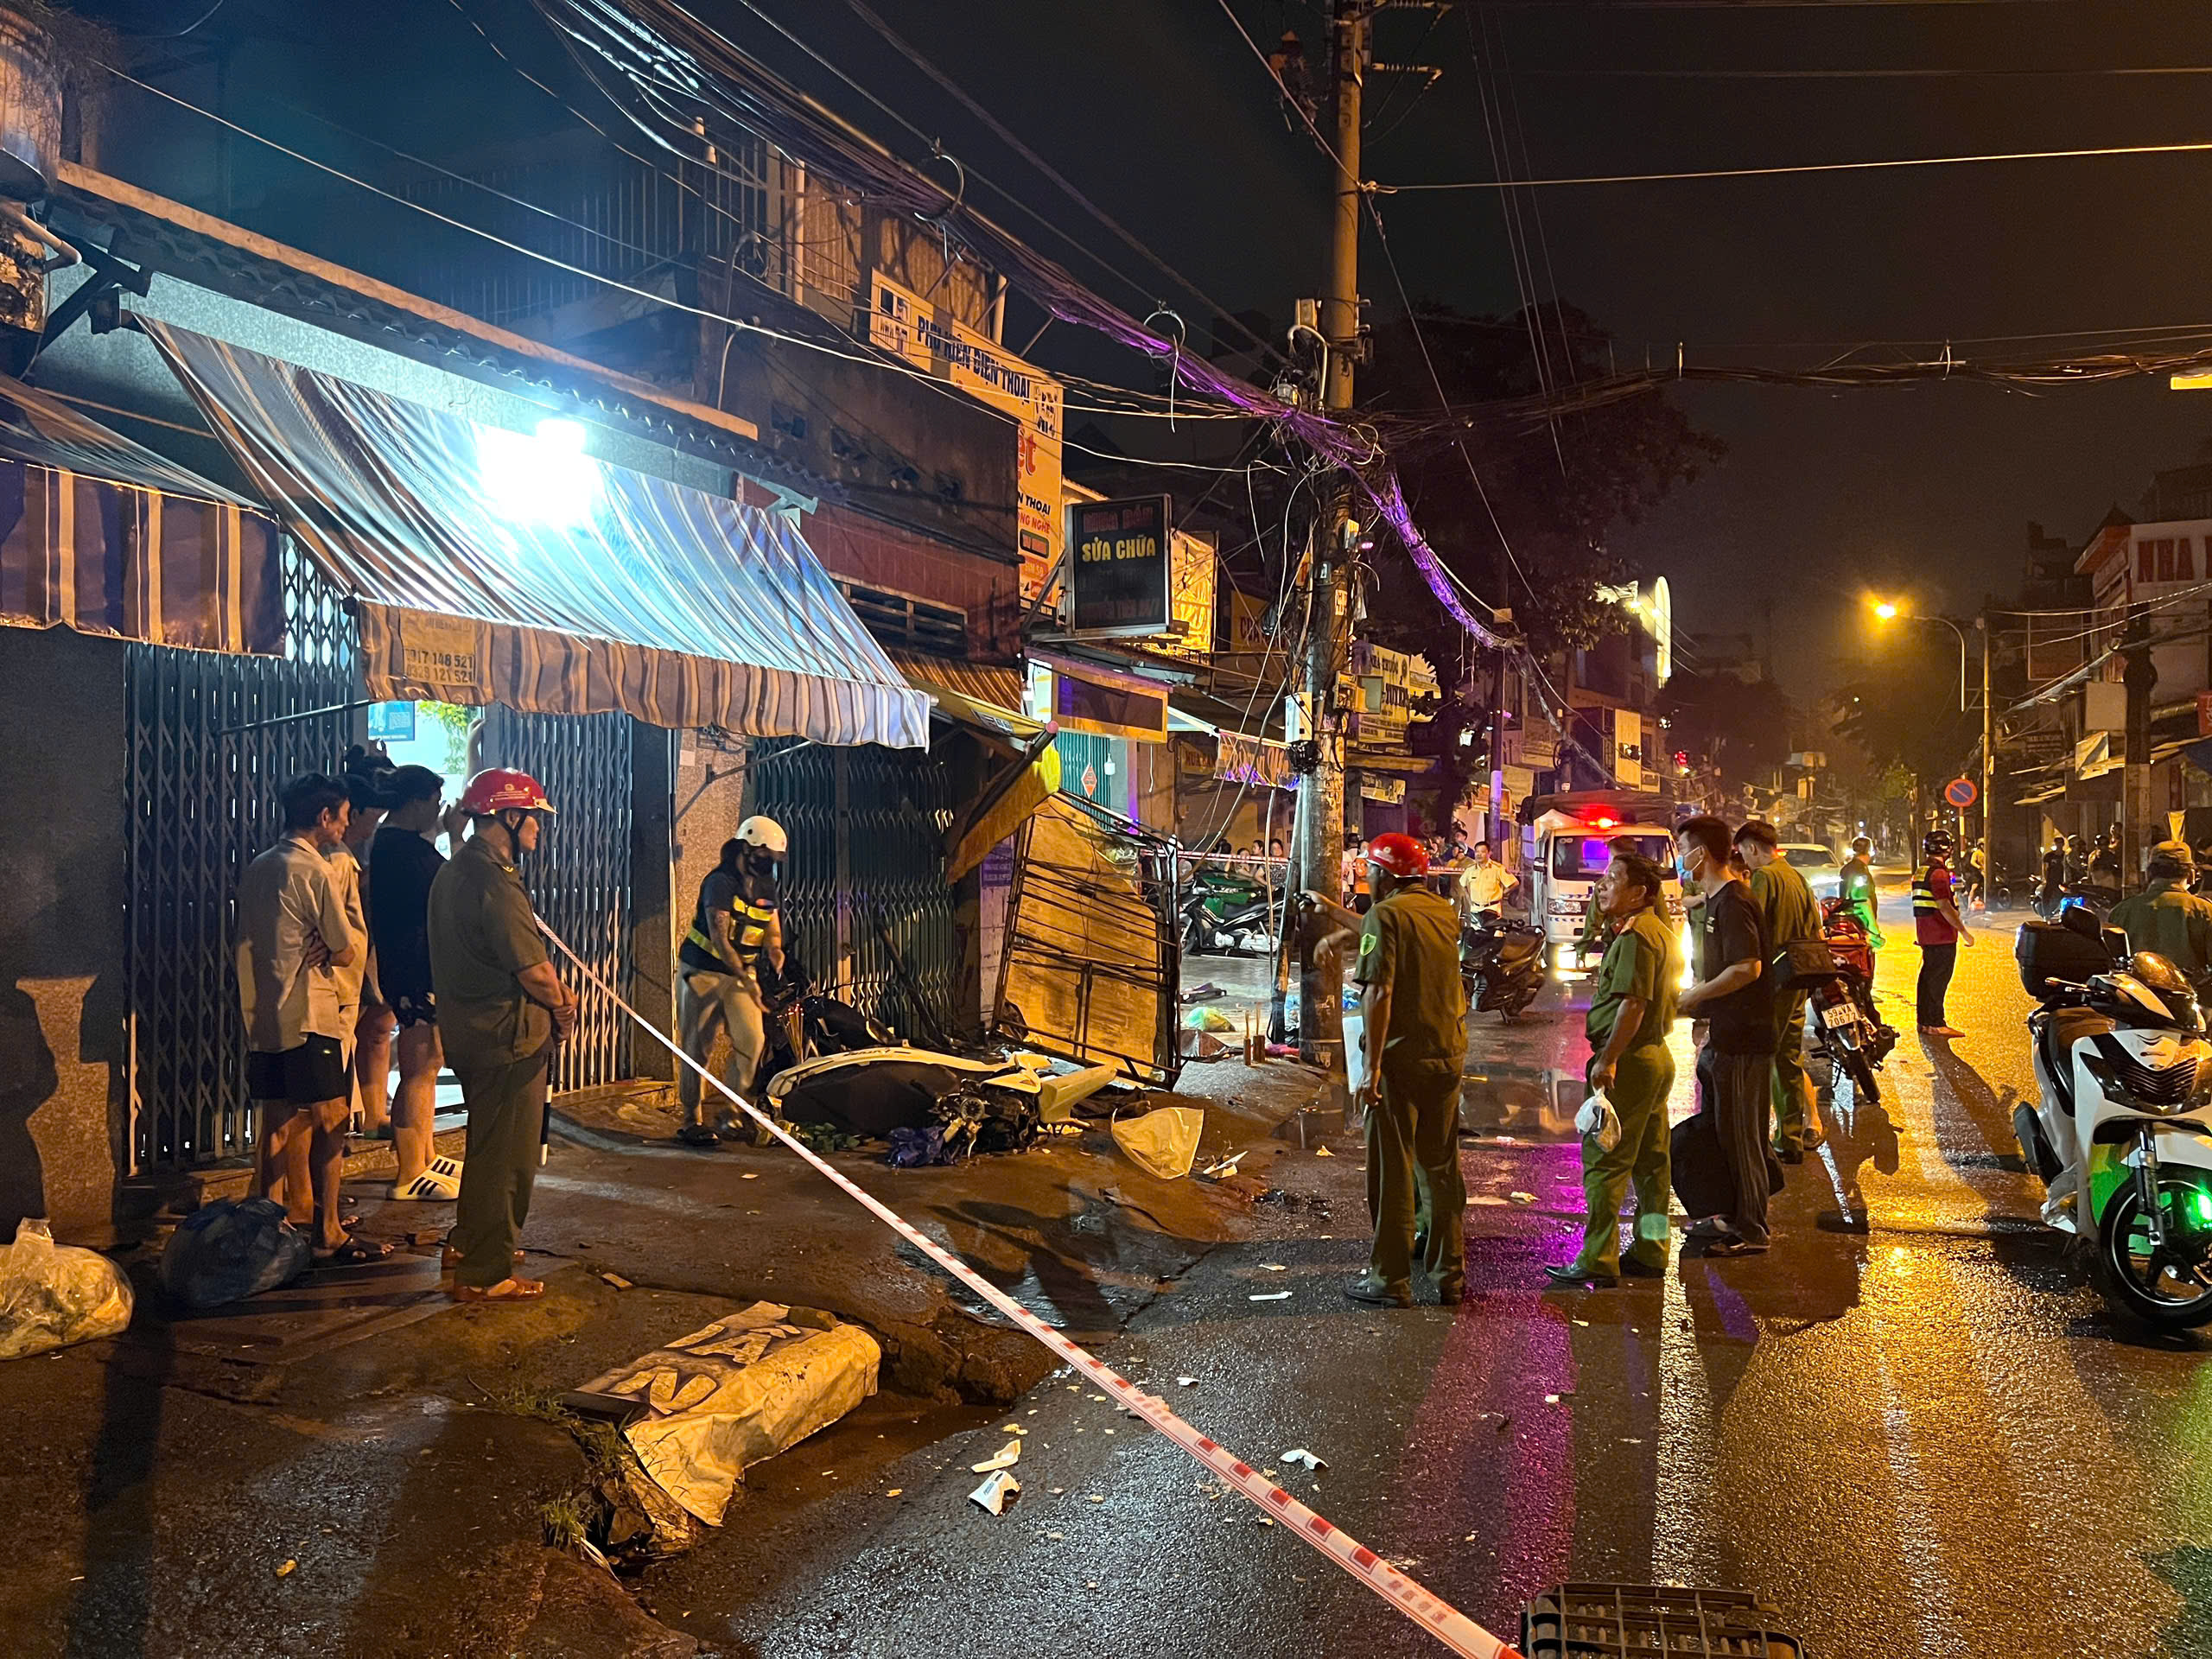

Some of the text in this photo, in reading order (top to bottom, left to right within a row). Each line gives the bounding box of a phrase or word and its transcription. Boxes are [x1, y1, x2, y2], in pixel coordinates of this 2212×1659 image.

[1001, 365, 1030, 405] THOẠI
[1026, 495, 1051, 517] THOẠI
[1082, 534, 1156, 562] SỬA CHỮA
[454, 655, 473, 669] 521
[454, 670, 473, 683] 521
